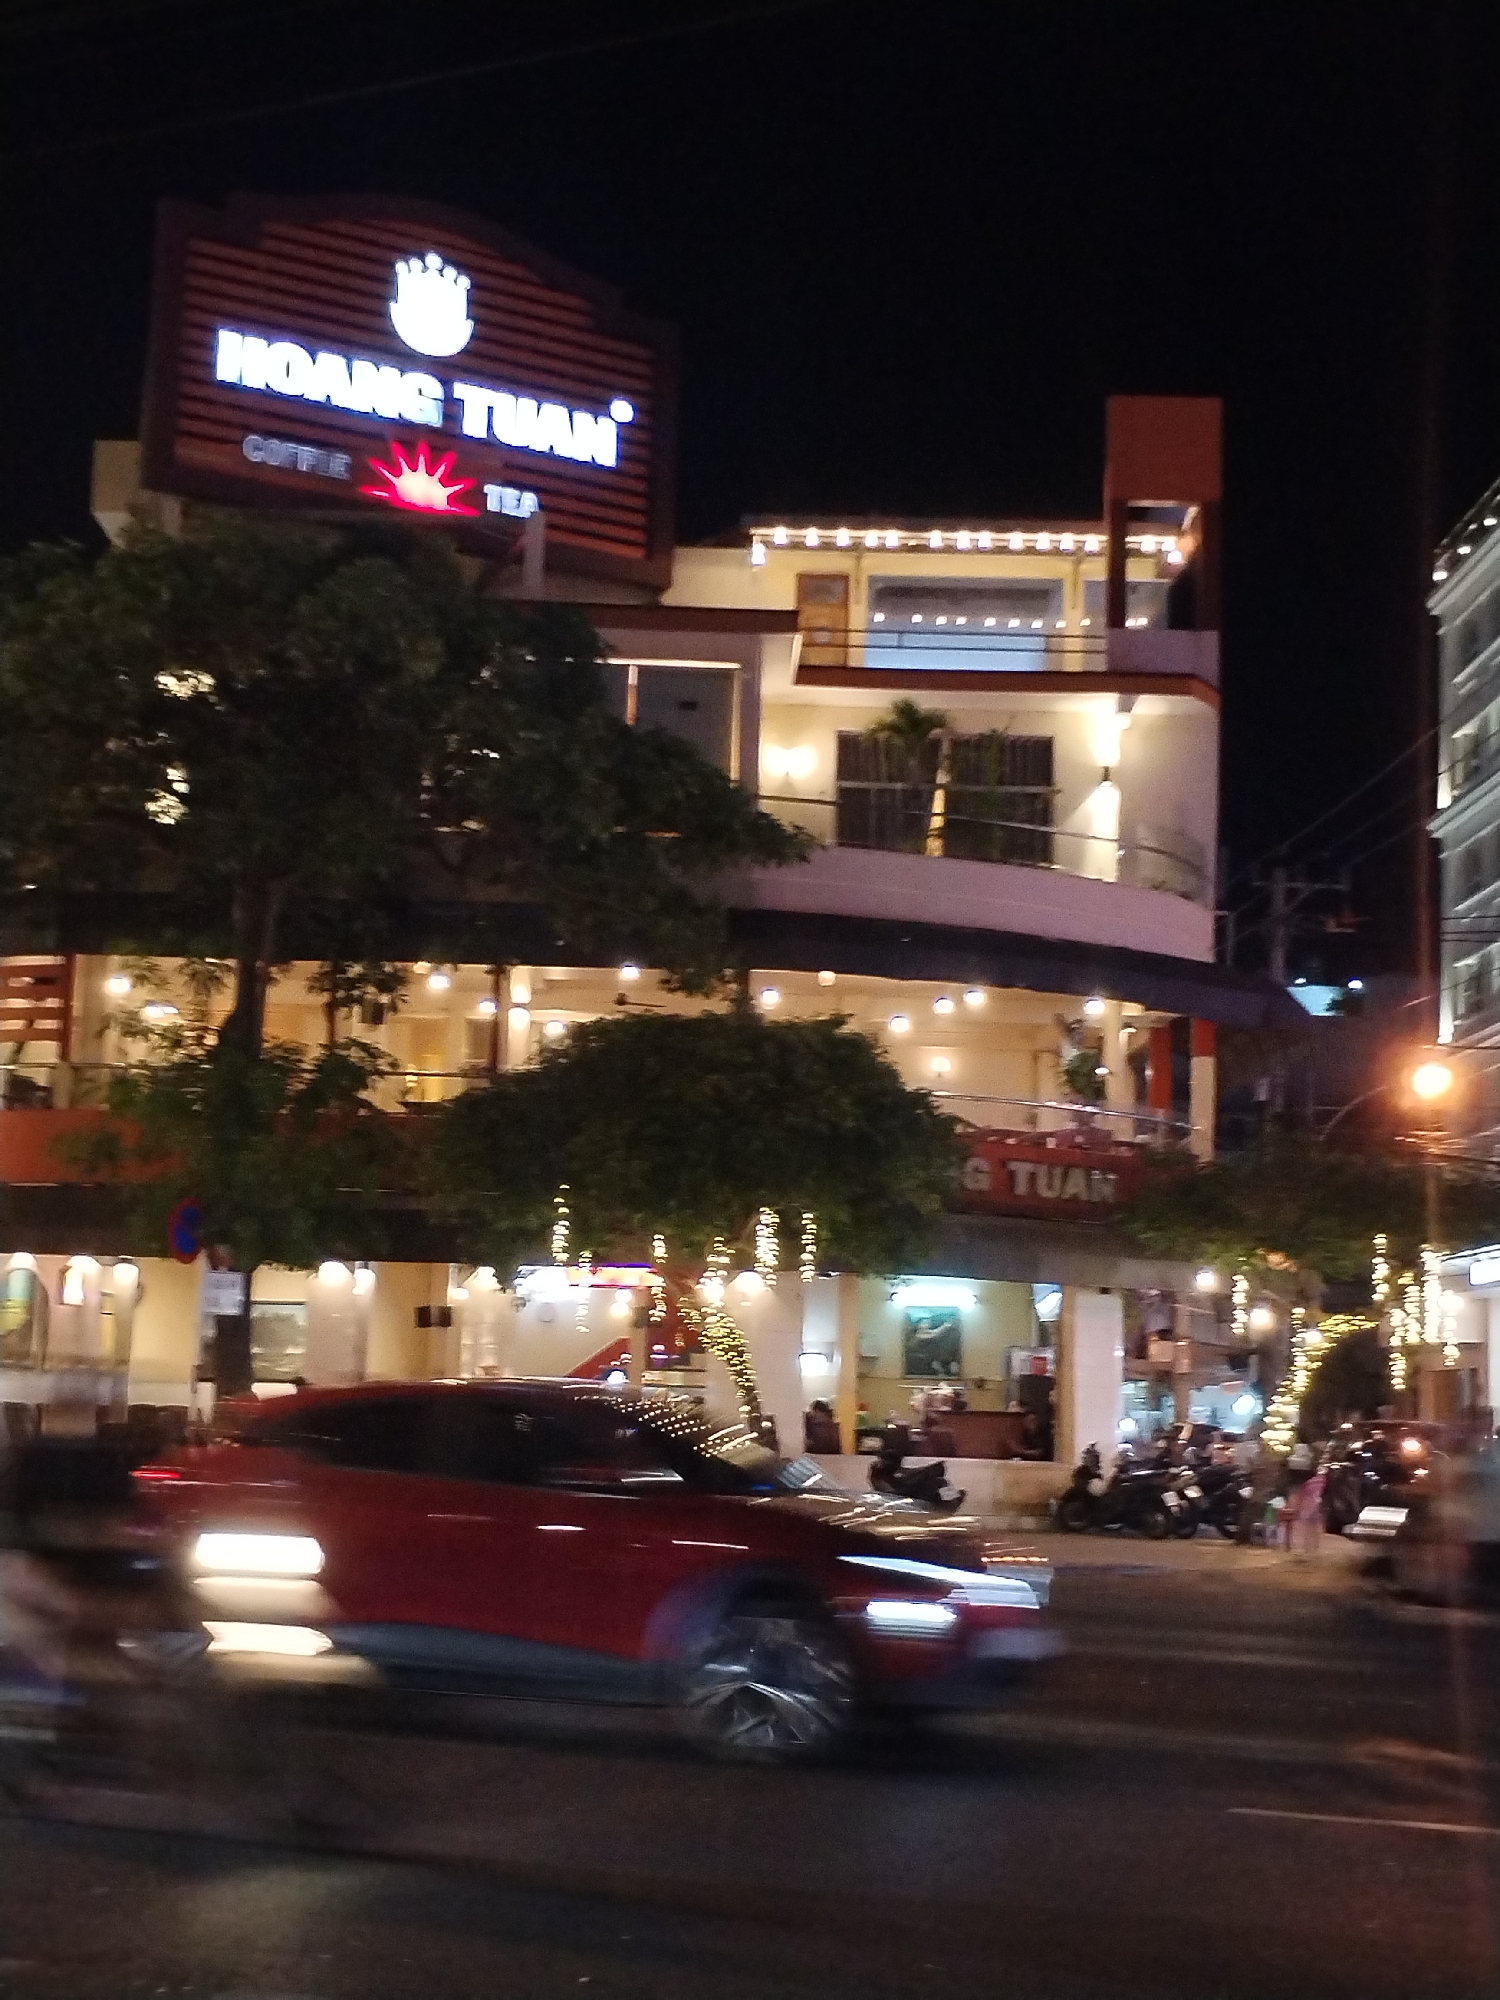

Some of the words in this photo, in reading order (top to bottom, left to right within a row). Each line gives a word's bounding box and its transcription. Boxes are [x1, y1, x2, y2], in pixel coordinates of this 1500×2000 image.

[215, 328, 444, 428] HOANG
[453, 381, 619, 468] TUAN
[484, 484, 540, 519] TEA
[959, 1156, 992, 1192] G
[1006, 1160, 1118, 1202] TUAN
